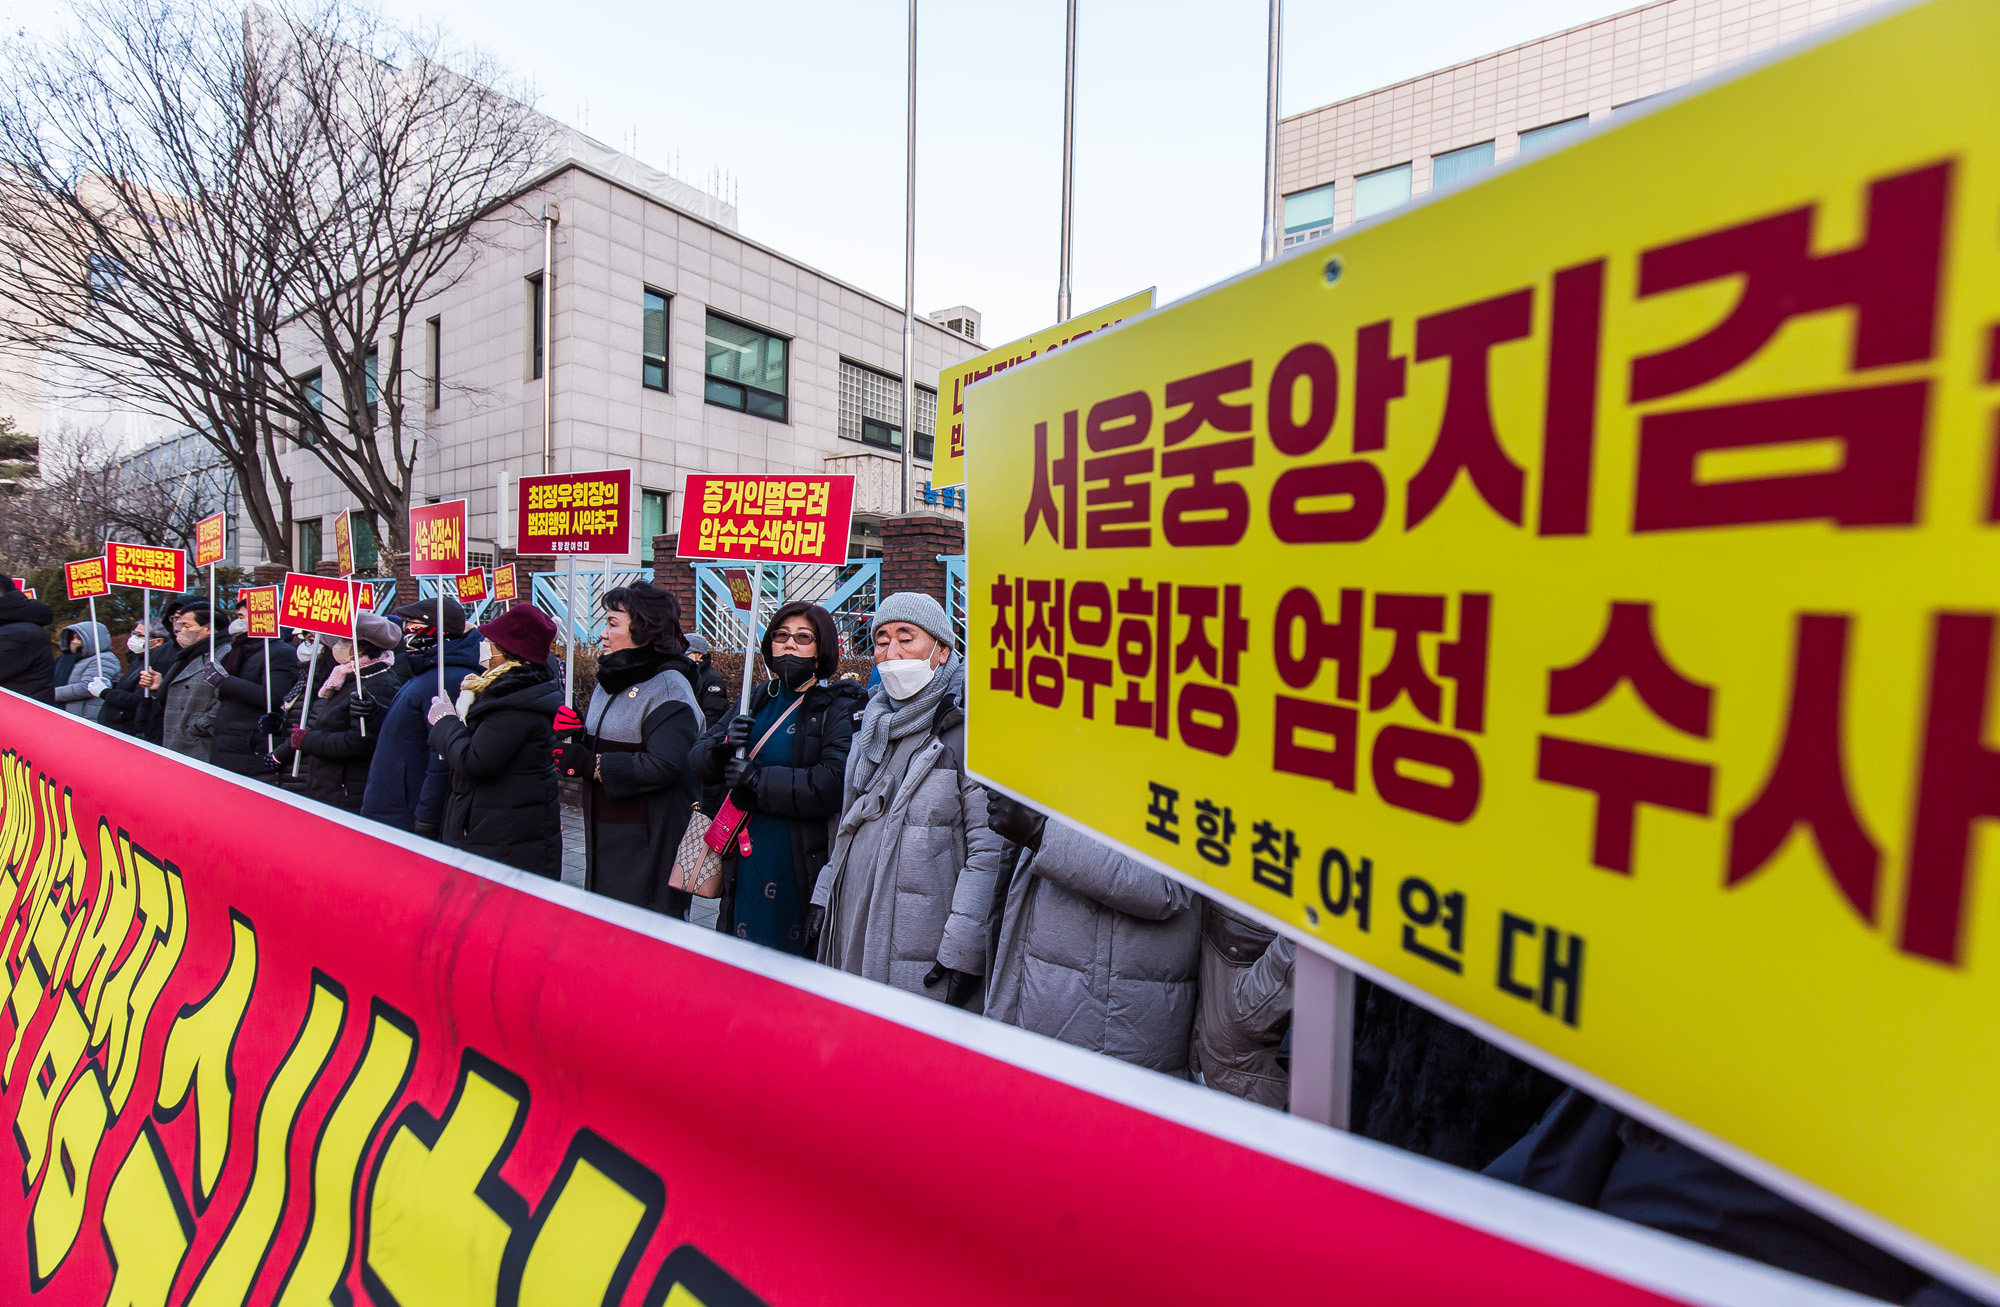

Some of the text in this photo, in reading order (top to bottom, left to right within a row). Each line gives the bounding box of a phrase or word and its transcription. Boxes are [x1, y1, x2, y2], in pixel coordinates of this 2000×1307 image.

[1022, 154, 2000, 550] 서울중앙지검
[528, 481, 619, 509] 최정우회장의
[702, 480, 831, 517] 증거인멸우려
[528, 509, 618, 536] 범죄행위 사익추구
[698, 518, 826, 557] 압수수색하라
[115, 546, 175, 569] 증거인멸우려
[115, 565, 176, 588] 압수수색하라
[990, 574, 1249, 758] 최정우회장
[1273, 584, 1493, 825] 엄정
